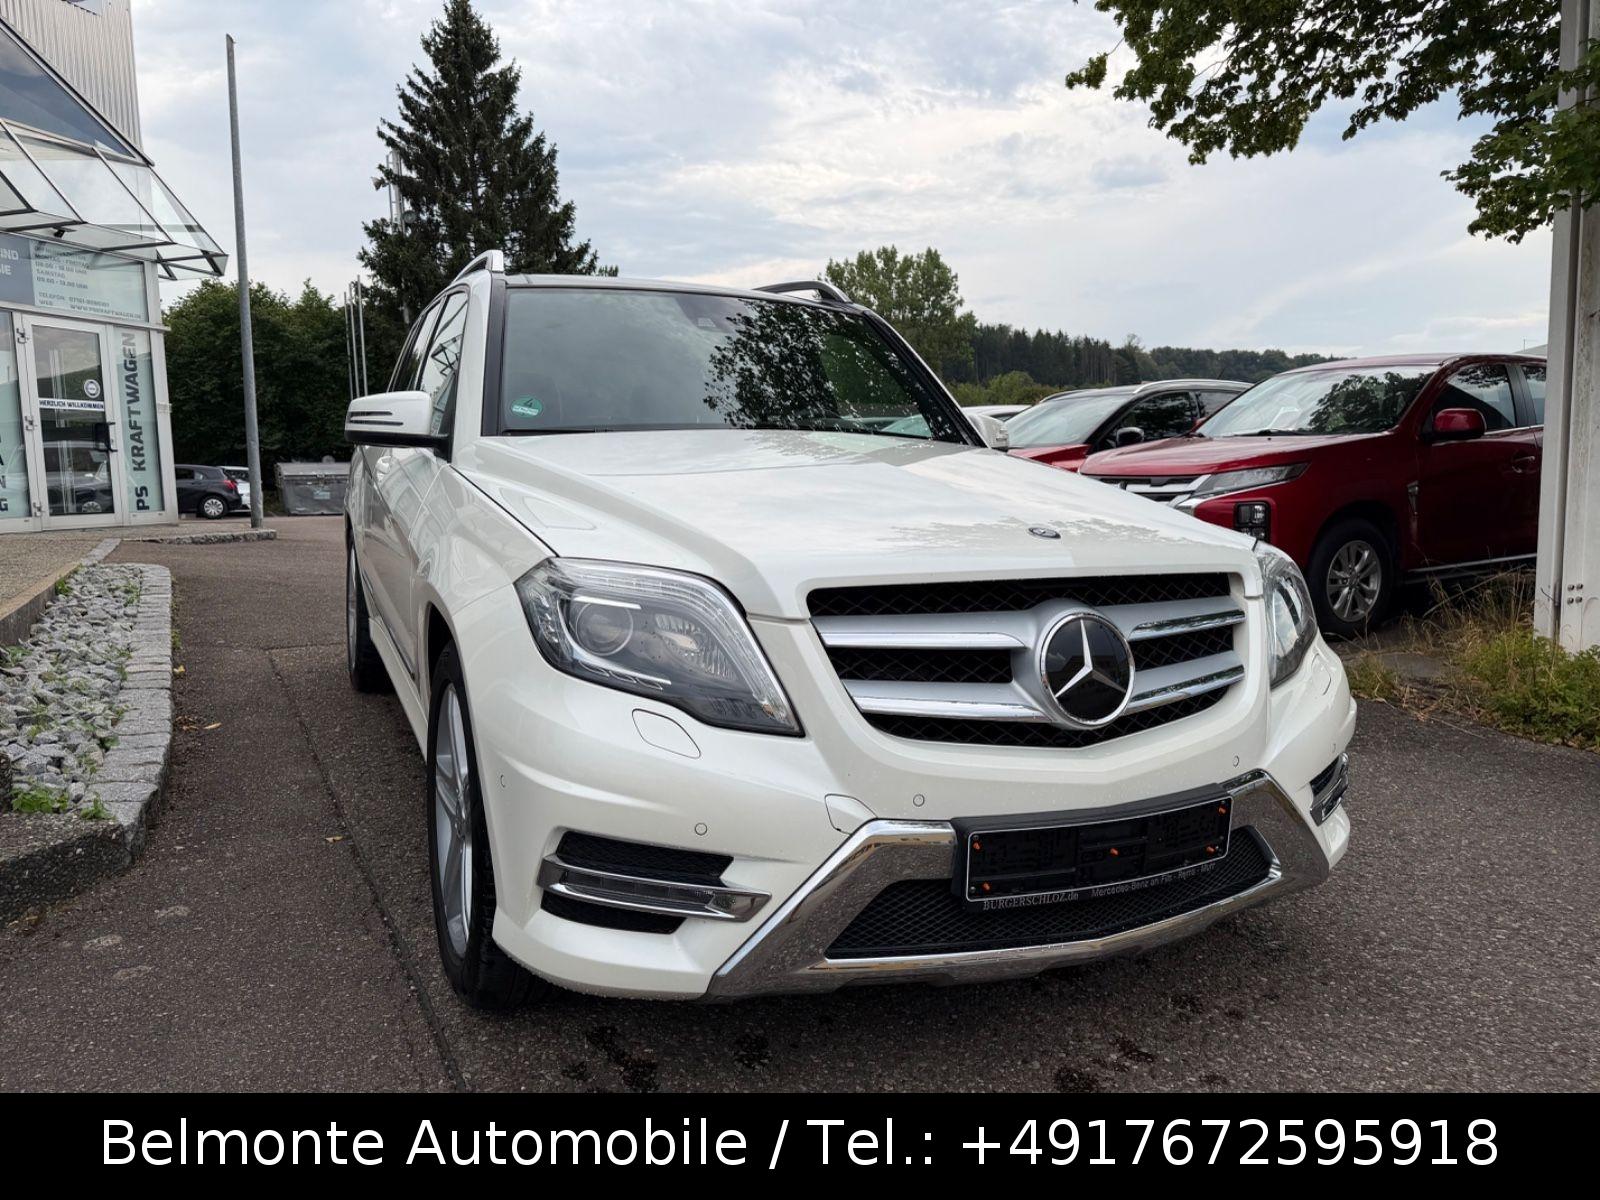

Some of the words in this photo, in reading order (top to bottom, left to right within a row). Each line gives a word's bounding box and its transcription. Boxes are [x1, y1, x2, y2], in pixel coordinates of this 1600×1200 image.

[40, 400, 66, 408] HERZLICH
[67, 401, 104, 410] WILLKOMMEN
[121, 332, 147, 472] KRAFTWAGEN
[135, 485, 150, 511] PS
[1091, 881, 1149, 897] Mercedes-Benz
